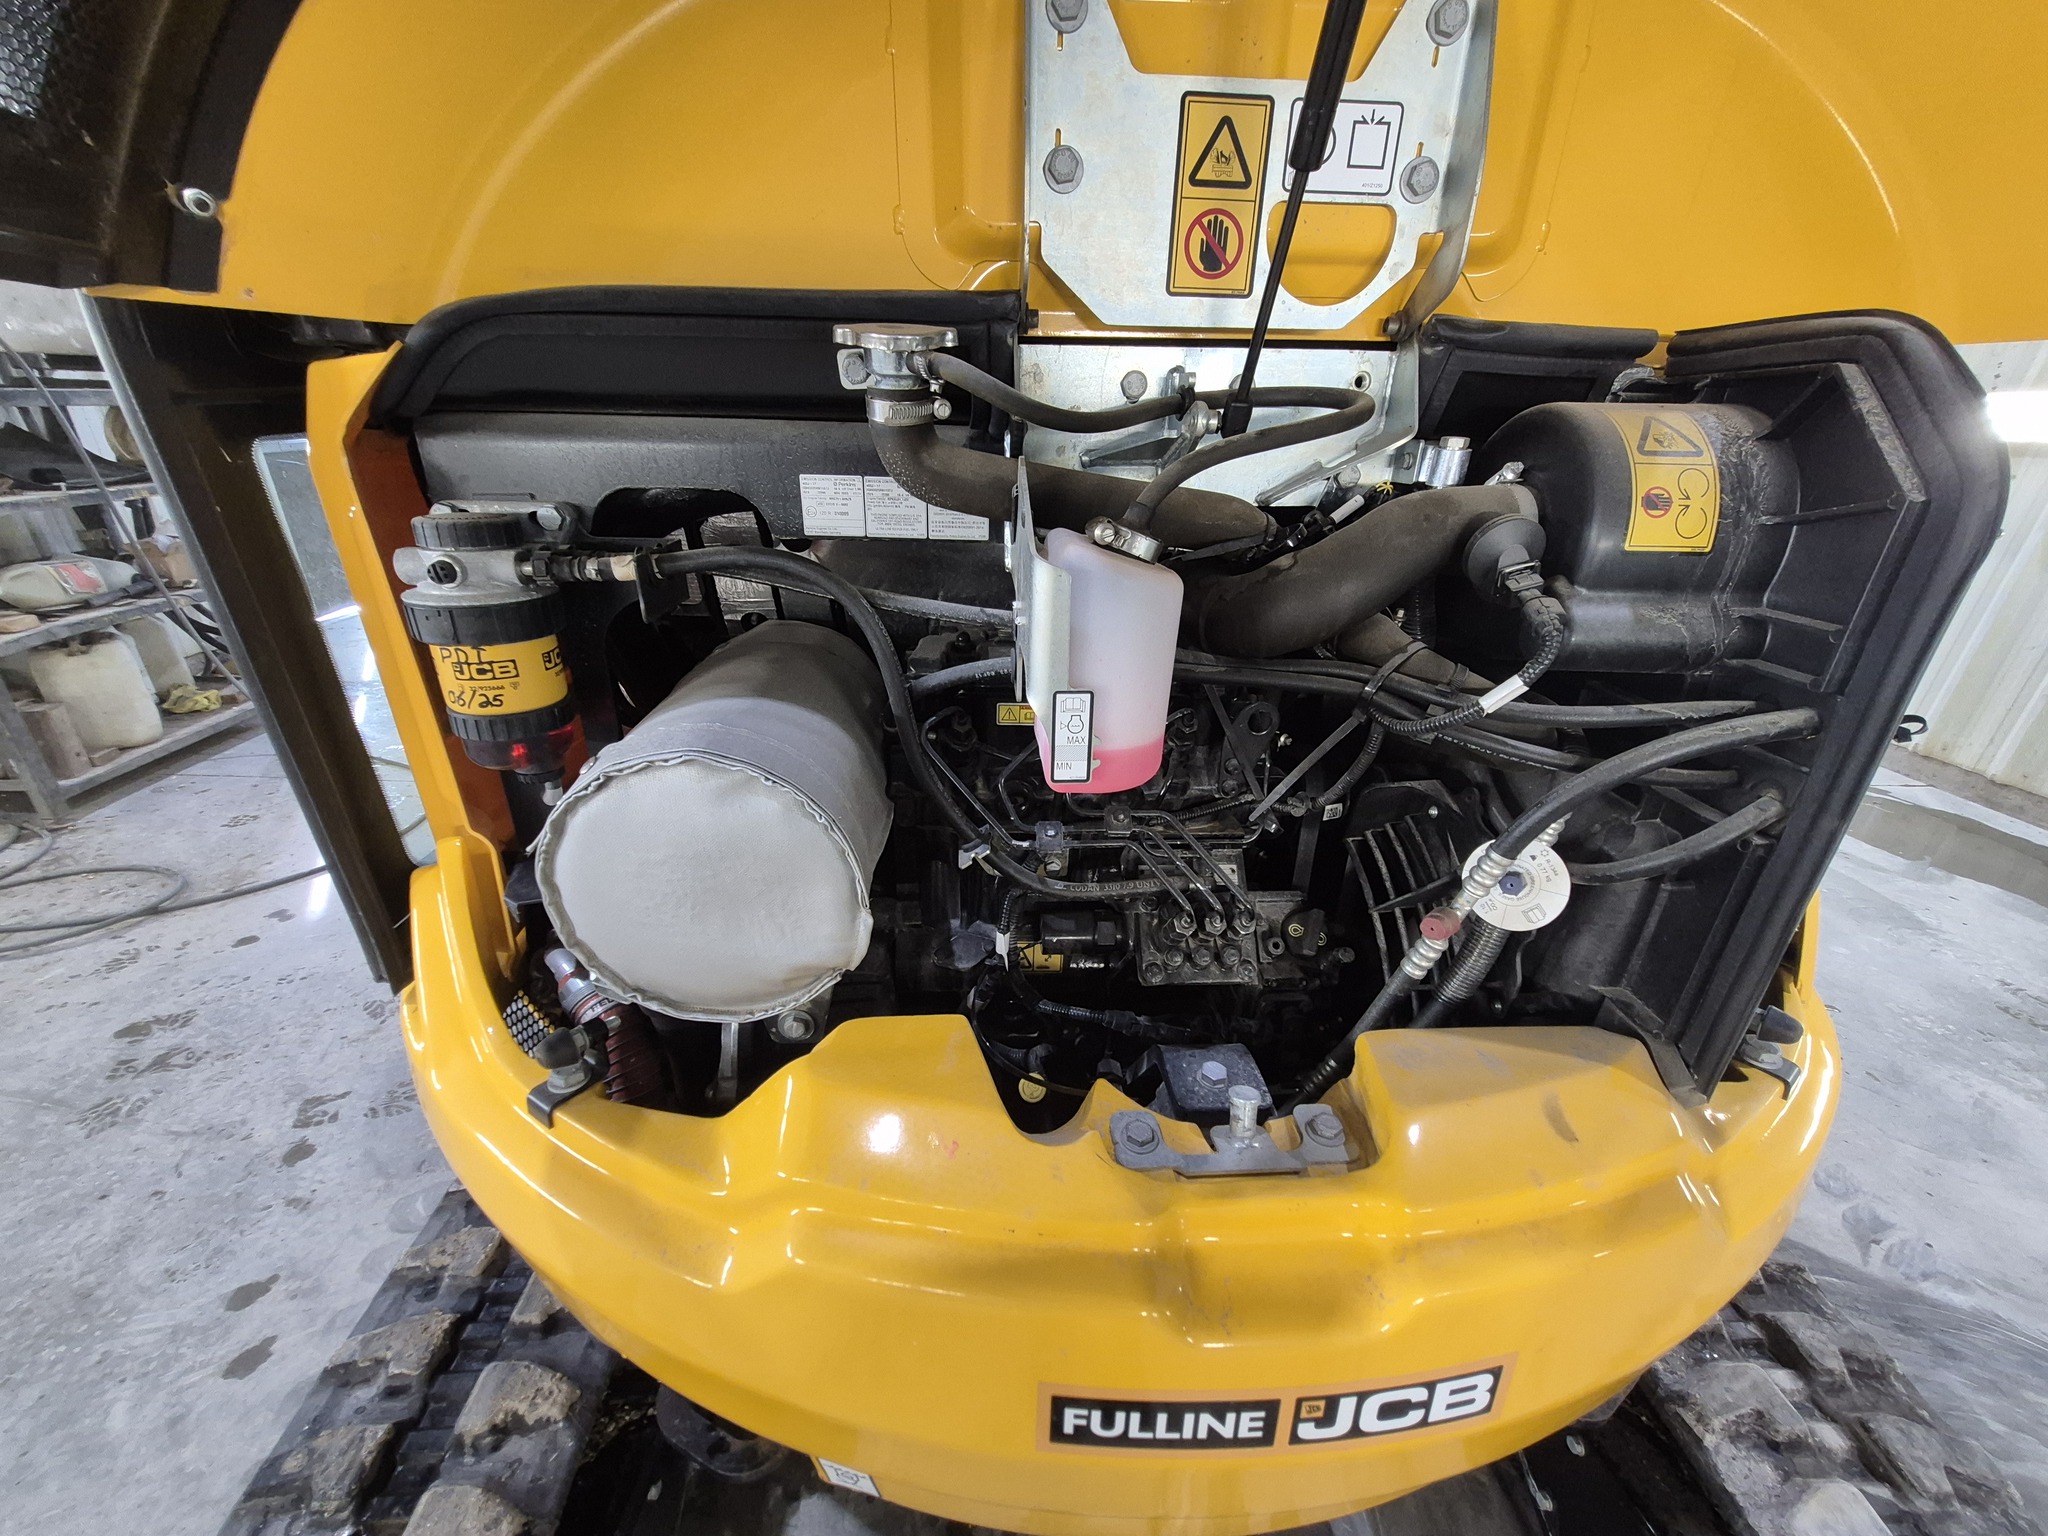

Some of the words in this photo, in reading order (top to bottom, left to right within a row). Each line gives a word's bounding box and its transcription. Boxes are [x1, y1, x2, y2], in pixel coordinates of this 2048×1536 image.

[452, 660, 519, 680] JCB
[1066, 736, 1086, 745] MAX
[1056, 762, 1073, 770] MIN
[1297, 1372, 1494, 1440] JCB
[1062, 1407, 1266, 1440] FULLINE
